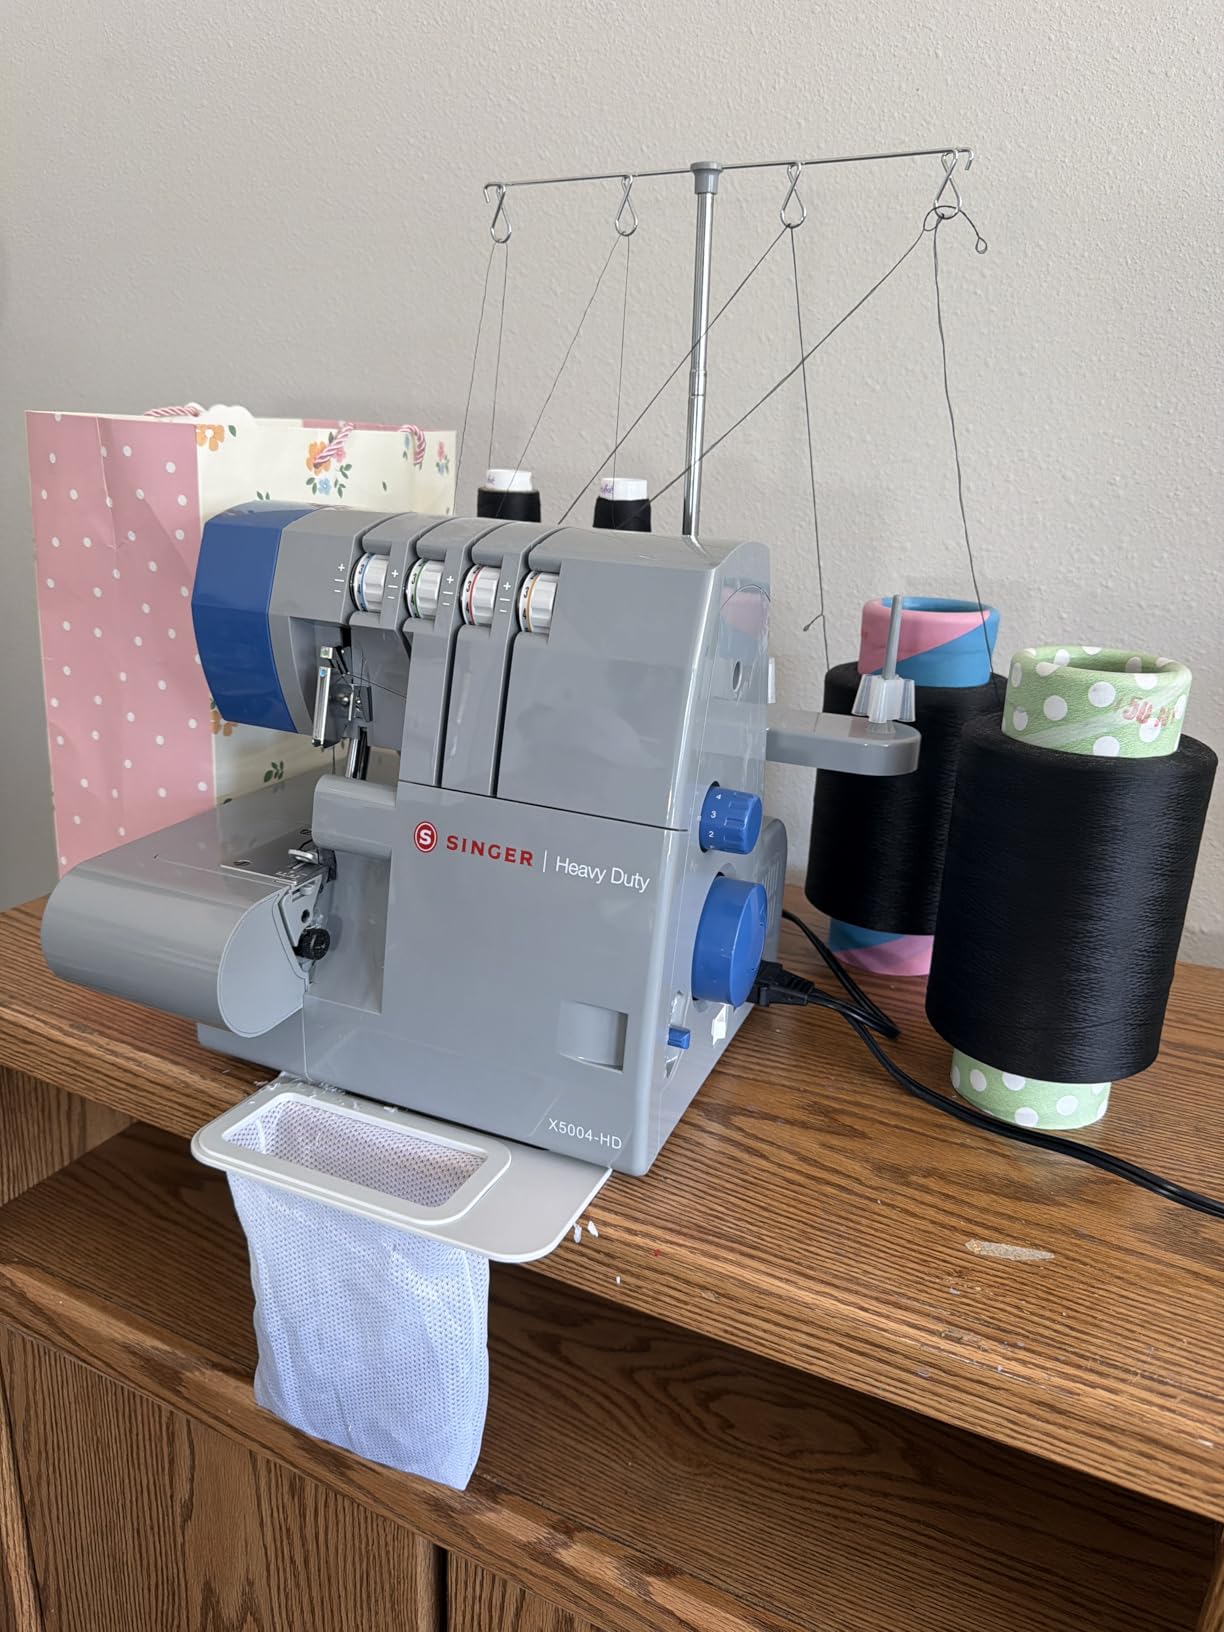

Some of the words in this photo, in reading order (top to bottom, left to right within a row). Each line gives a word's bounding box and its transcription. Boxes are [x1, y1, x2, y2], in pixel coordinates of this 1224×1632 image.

[523, 586, 530, 598] 3
[710, 810, 717, 819] 3
[708, 830, 715, 838] 2
[446, 834, 534, 867] SINGER
[555, 855, 607, 884] Heavy
[611, 867, 651, 893] Duty
[548, 1117, 623, 1150] X5004-HD
